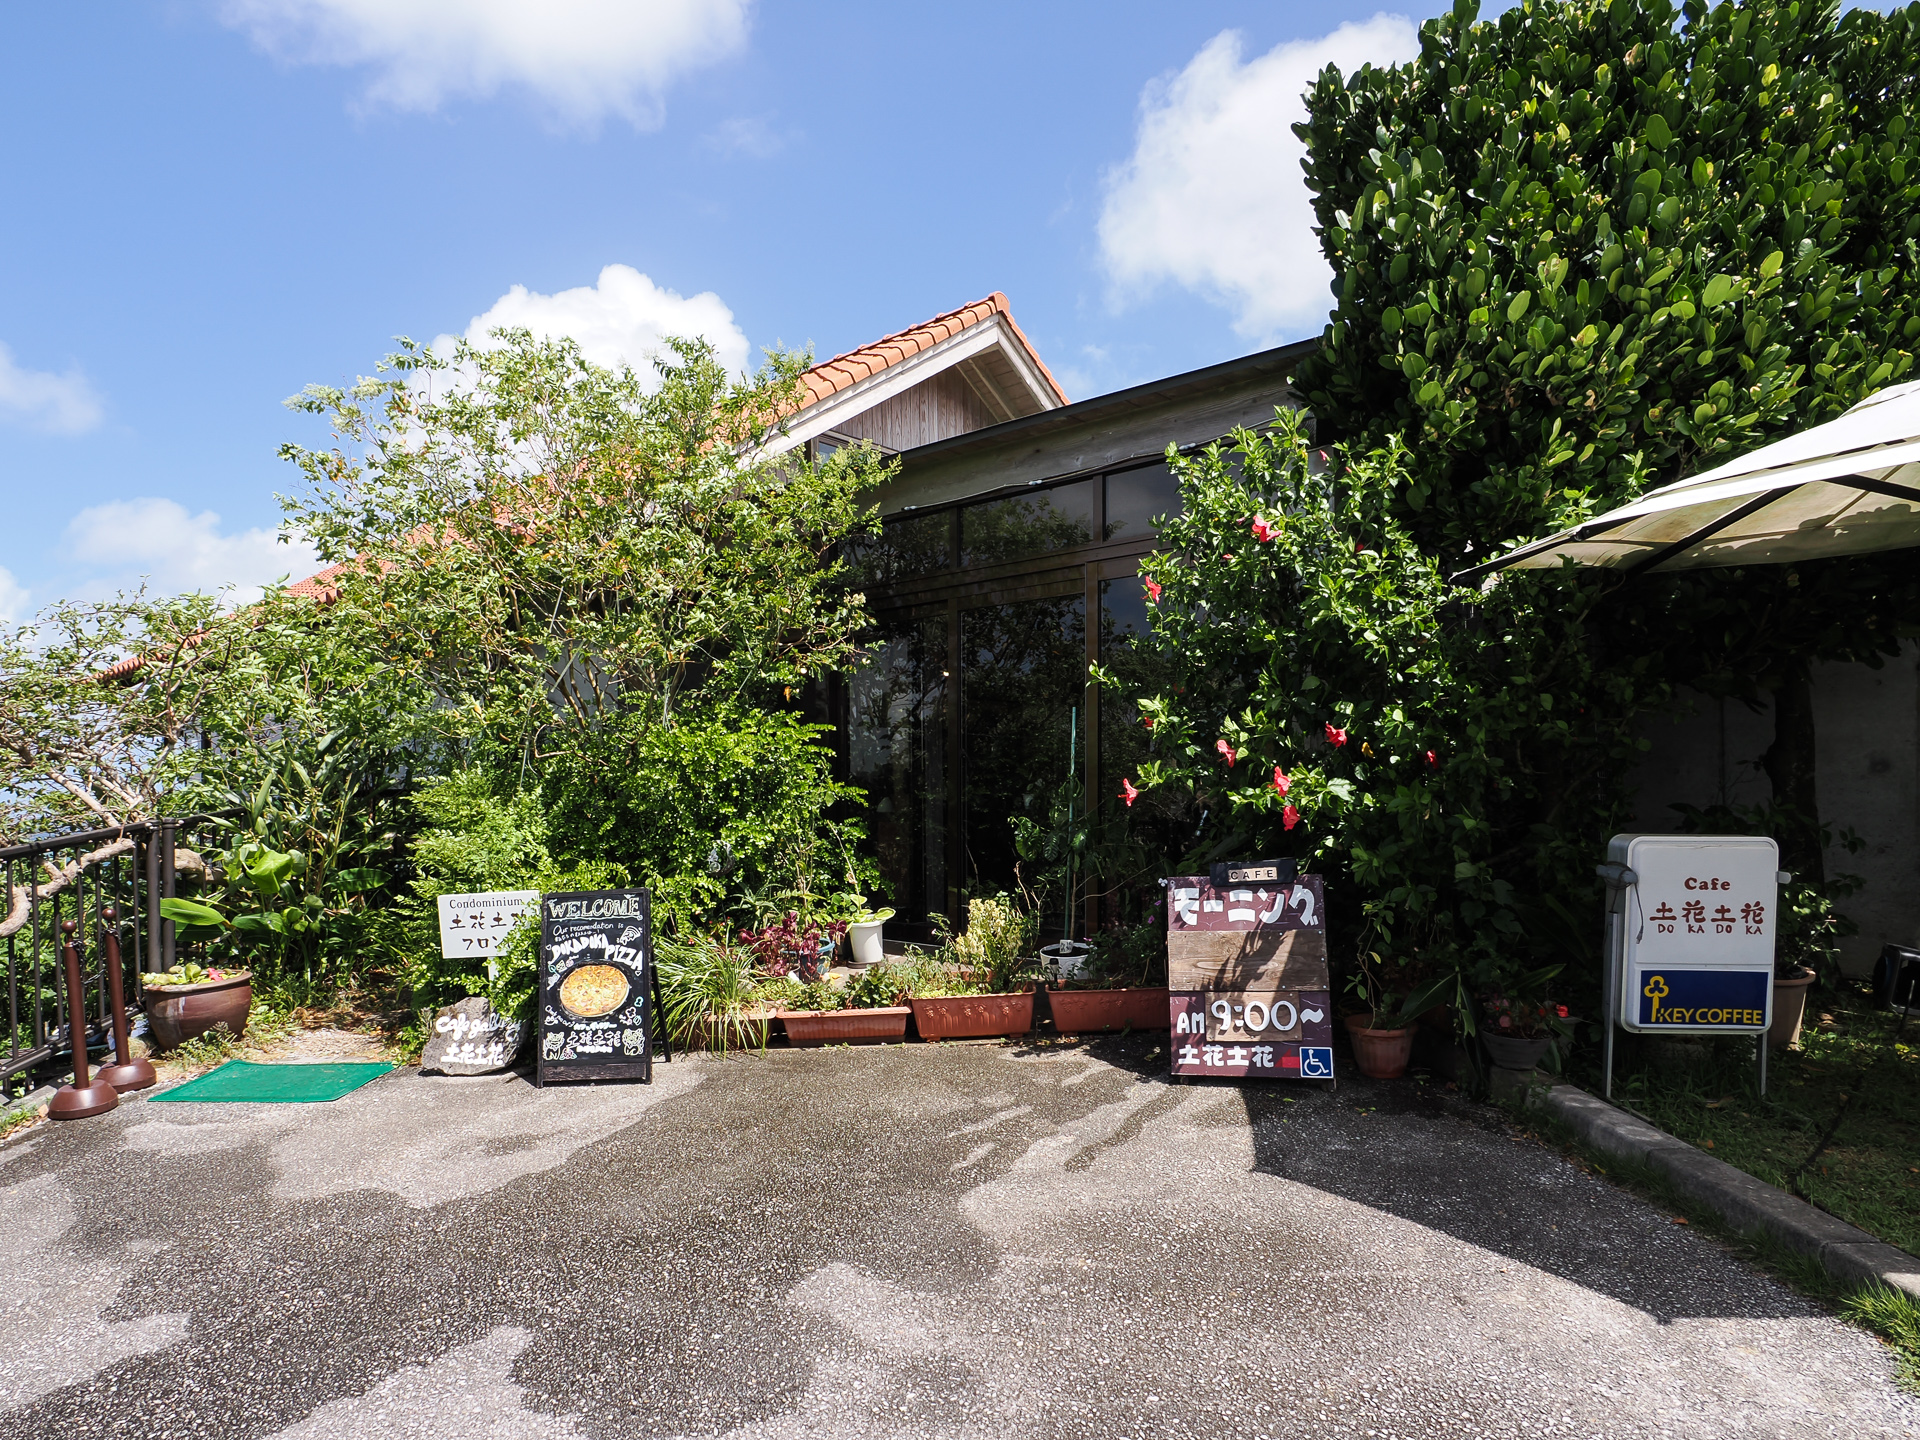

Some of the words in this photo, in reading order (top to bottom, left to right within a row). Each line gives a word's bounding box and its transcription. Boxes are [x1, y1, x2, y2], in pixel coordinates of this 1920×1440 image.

[1230, 869, 1275, 881] CAFE
[1684, 877, 1731, 891] Cafe
[449, 897, 523, 909] Condominium
[548, 897, 641, 918] WELCOME
[1174, 885, 1319, 926] モーニング
[1649, 900, 1765, 924] 土花土花
[553, 924, 568, 936] Our
[1658, 923, 1675, 934] DO
[1687, 923, 1705, 934] KA
[1716, 923, 1733, 934] DO
[1745, 925, 1763, 935] KA
[462, 936, 511, 951] フロン
[604, 944, 643, 971] PIZZA
[1176, 1012, 1205, 1034] AM
[1657, 1007, 1695, 1023] KEY
[1695, 1008, 1763, 1025] COFFEE
[440, 1042, 504, 1066] 土花土花
[1178, 1044, 1275, 1068] 土花土花
